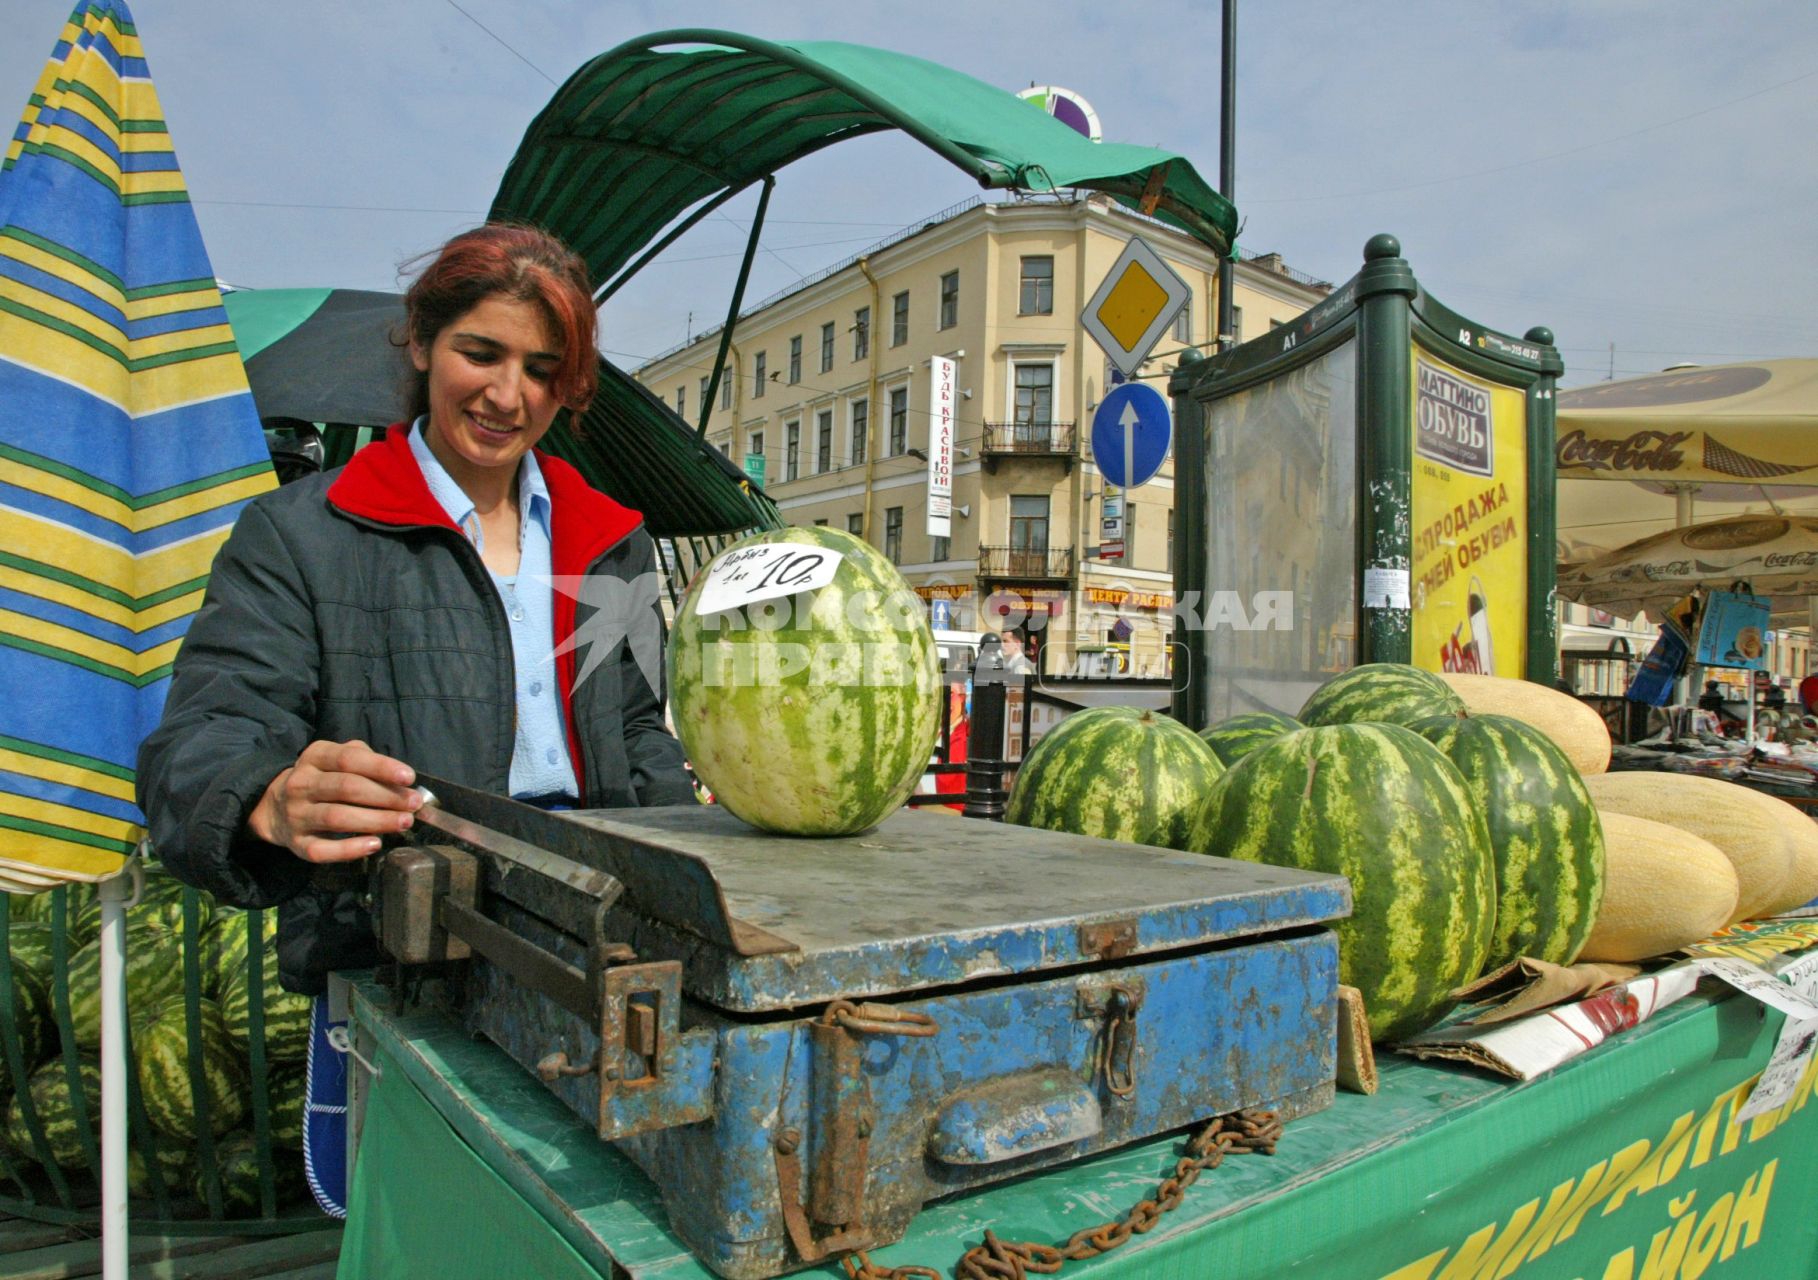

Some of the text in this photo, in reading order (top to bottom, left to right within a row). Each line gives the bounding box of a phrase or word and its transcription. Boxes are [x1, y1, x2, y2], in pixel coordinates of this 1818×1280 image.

[1283, 331, 1296, 351] A1
[940, 361, 951, 401] БУДЬ
[1417, 365, 1487, 414] МАТТИНО
[1418, 395, 1485, 449] ОБУВЬ
[939, 405, 951, 487] КРАСИВОЙ
[1556, 429, 1694, 471] Coca-Cola
[1457, 516, 1518, 569] ОБУВИ
[1088, 588, 1129, 604] ЦЕНТР
